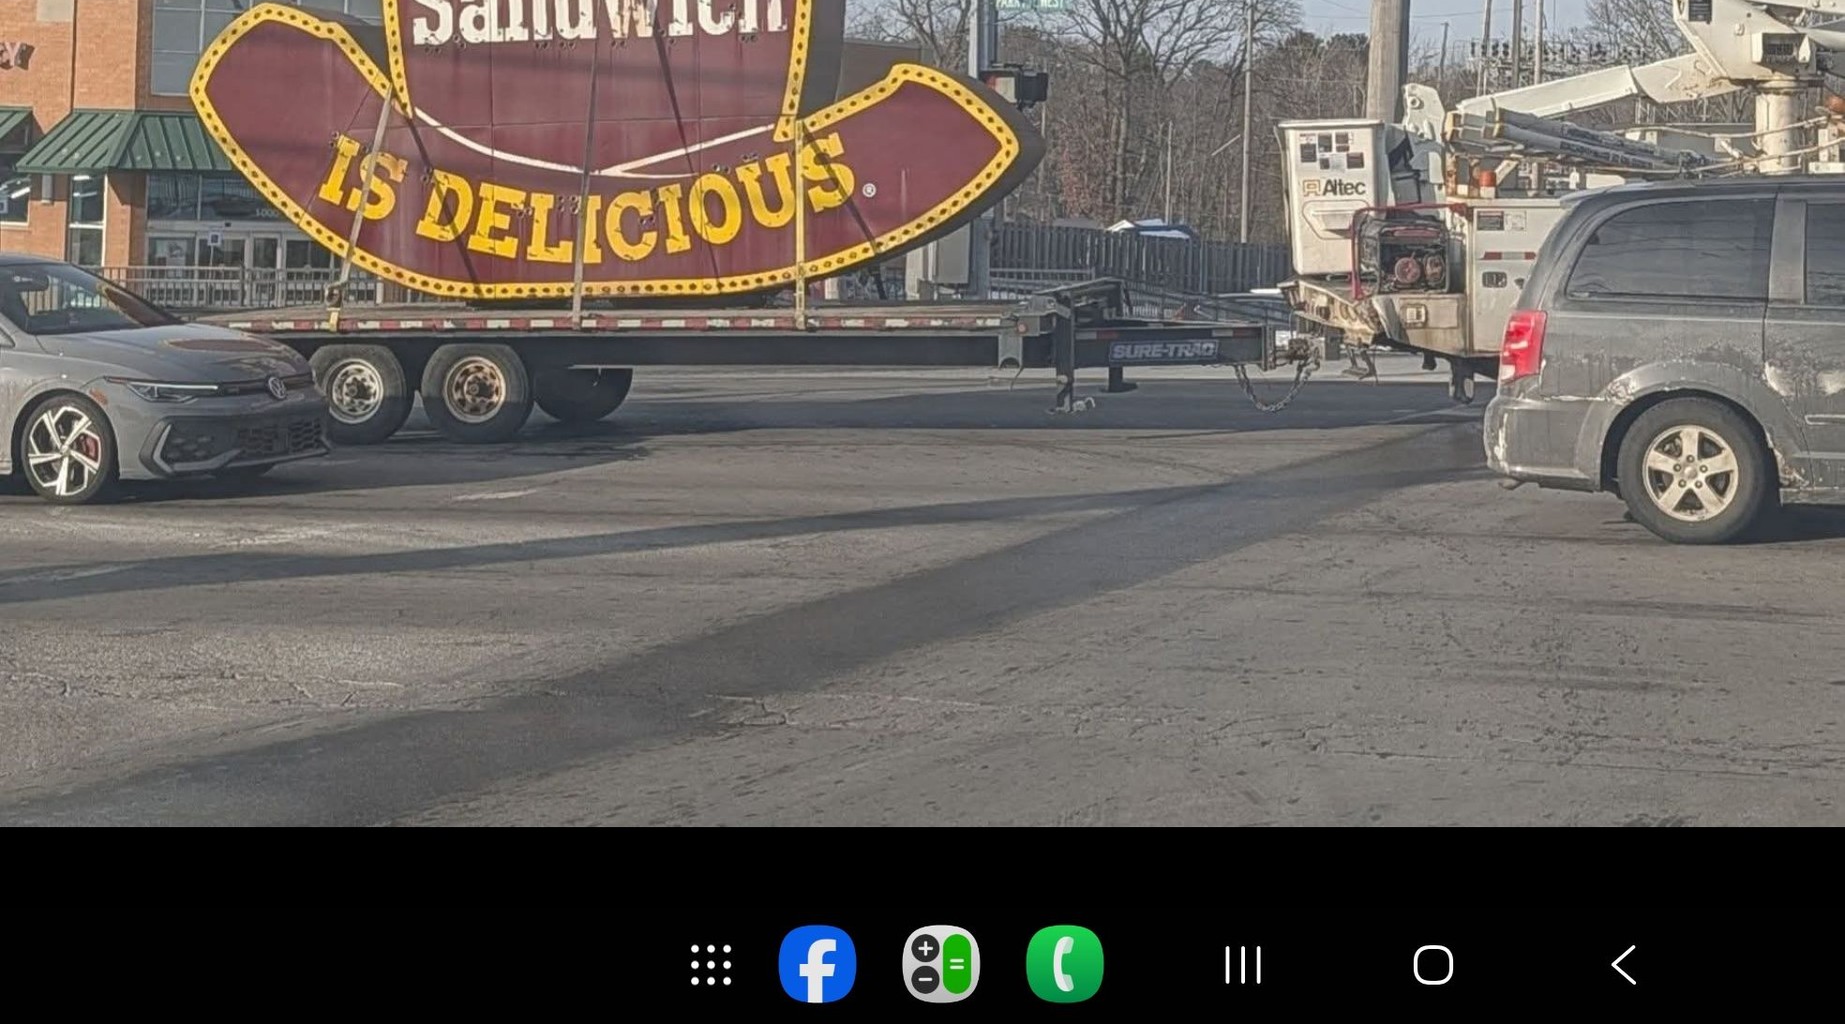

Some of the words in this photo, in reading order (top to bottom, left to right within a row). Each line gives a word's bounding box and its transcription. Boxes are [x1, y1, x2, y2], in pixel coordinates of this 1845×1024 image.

[319, 134, 408, 220] IS
[416, 132, 855, 264] DELICIOUS
[1323, 178, 1366, 196] Altec
